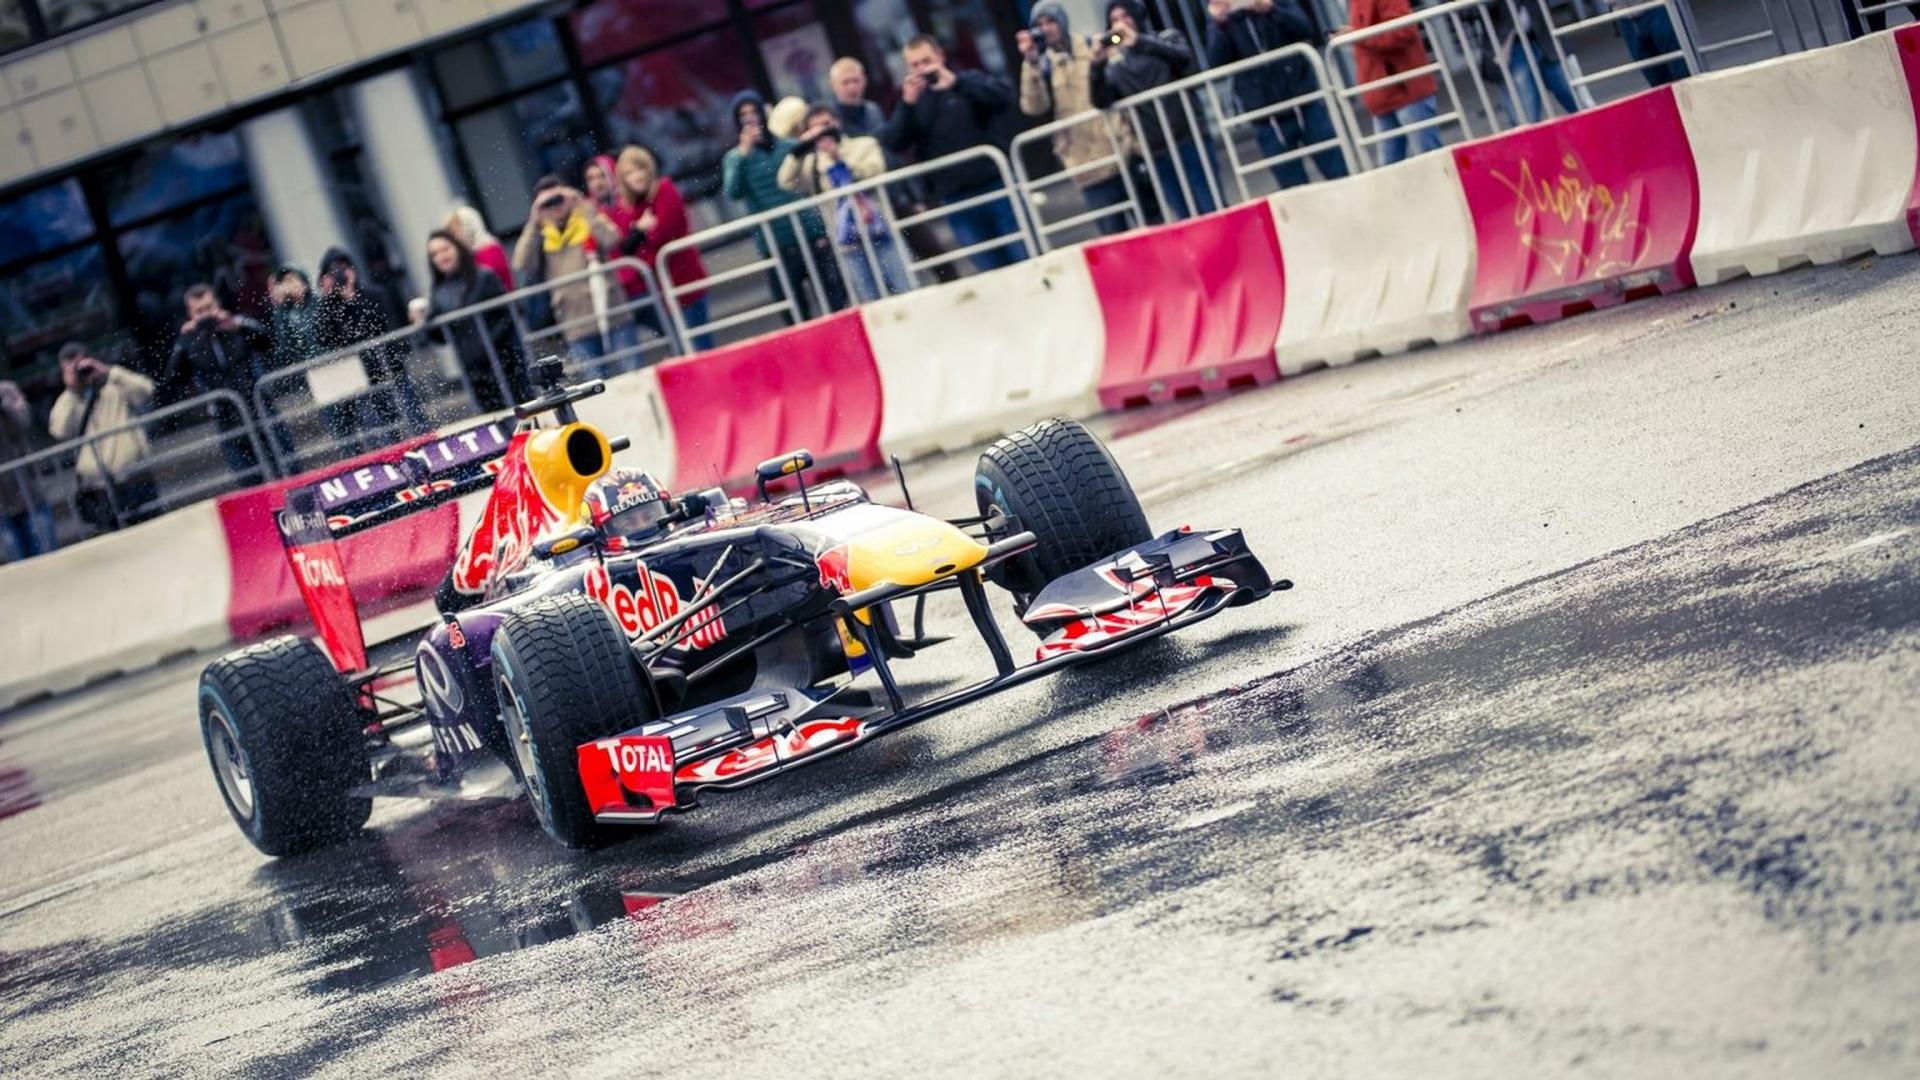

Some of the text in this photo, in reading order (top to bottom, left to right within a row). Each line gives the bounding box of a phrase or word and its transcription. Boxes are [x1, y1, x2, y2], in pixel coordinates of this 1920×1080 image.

[611, 490, 659, 515] RENAULT
[292, 552, 345, 587] TOTAL
[596, 739, 672, 774] TOTAL
